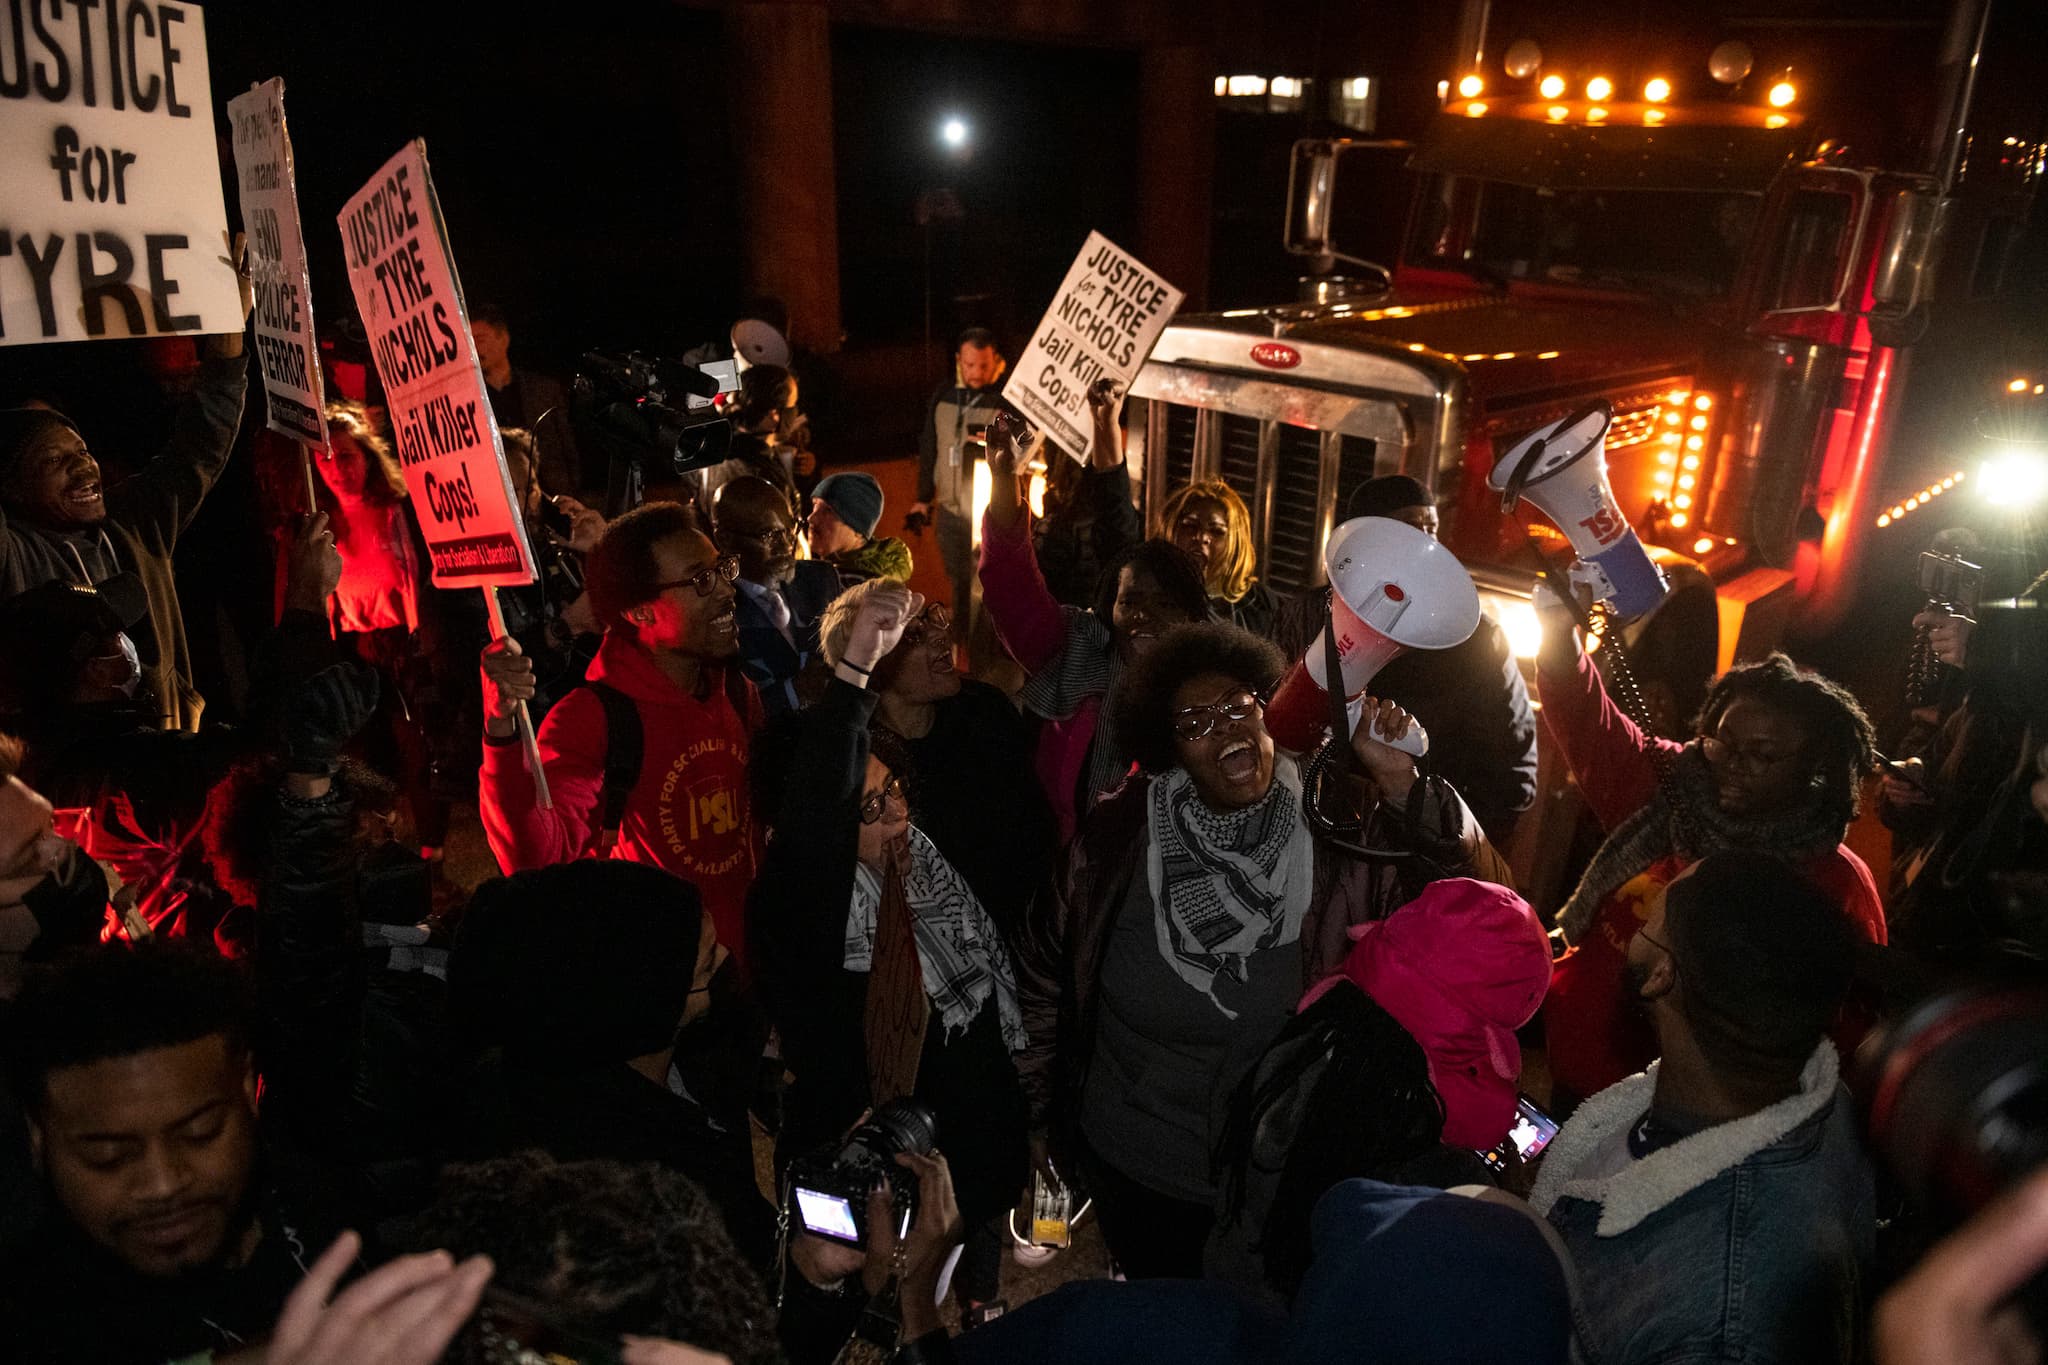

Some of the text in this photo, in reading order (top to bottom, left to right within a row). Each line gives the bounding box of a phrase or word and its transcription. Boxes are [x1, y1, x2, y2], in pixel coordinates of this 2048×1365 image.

[51, 124, 136, 204] for
[252, 208, 282, 261] END
[348, 164, 419, 270] JUSTICE
[255, 281, 301, 333] POLICE
[375, 237, 433, 319] TYRE
[1073, 272, 1147, 338] for TYRE
[1087, 246, 1168, 315] JUSTICE
[258, 334, 311, 393] TERROR
[376, 302, 458, 389] NICHOLS
[1038, 327, 1106, 387] Jail Kill
[1057, 293, 1136, 368] NICHOLS
[1038, 364, 1082, 417] Cops!
[397, 394, 481, 467] Jail Killer
[425, 462, 480, 533] Cops!
[1336, 633, 1354, 657] YLE
[661, 770, 681, 802] FOR
[658, 805, 687, 854] PARTY
